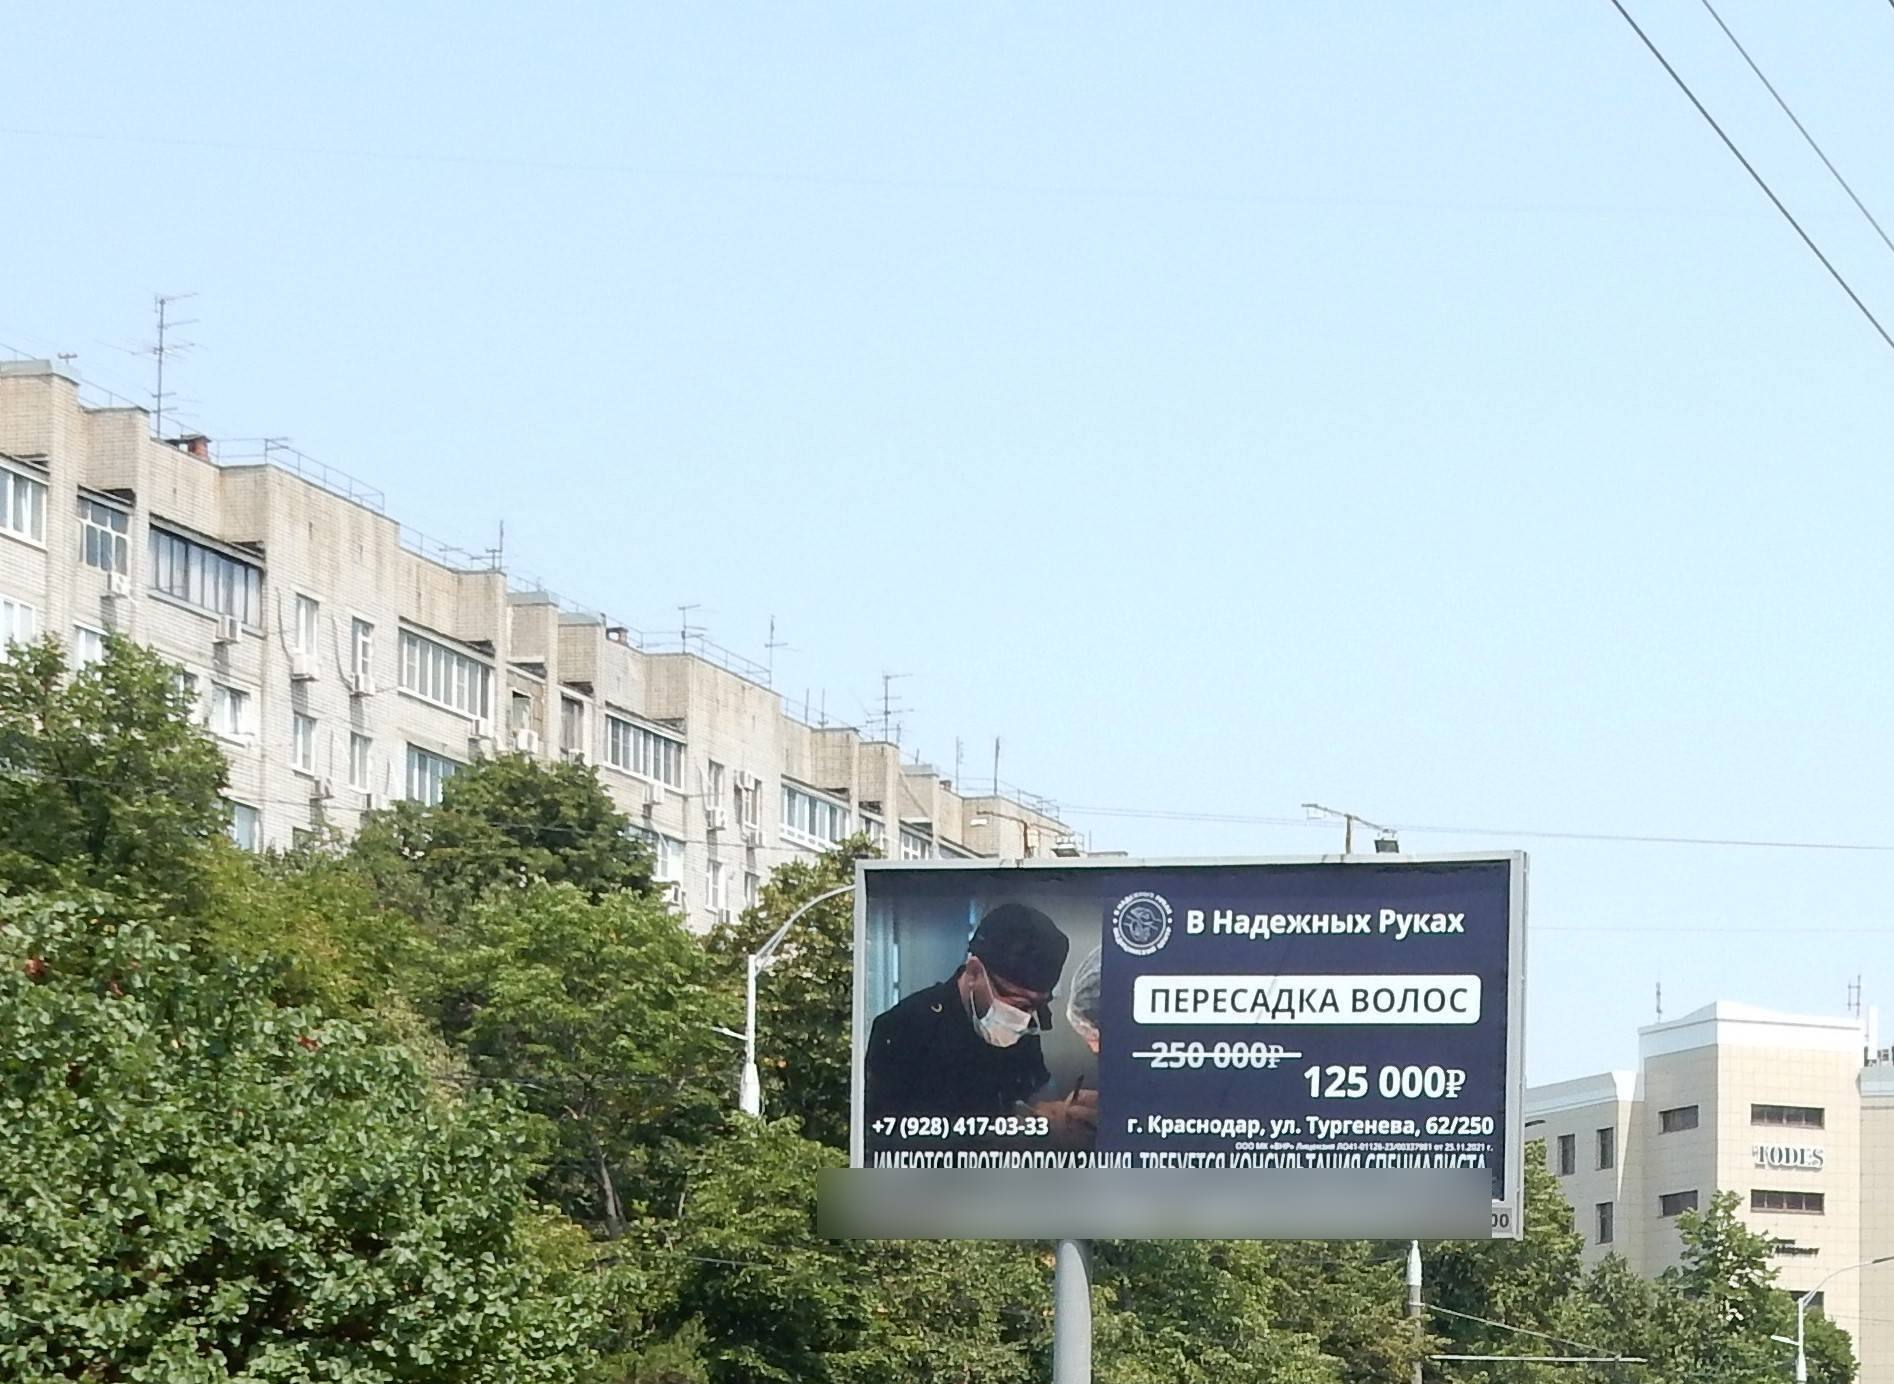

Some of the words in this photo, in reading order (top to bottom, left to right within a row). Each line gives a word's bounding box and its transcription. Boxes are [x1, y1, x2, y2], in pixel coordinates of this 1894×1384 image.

[1187, 911, 1204, 934] В
[1213, 910, 1371, 939] Надежных
[1379, 909, 1465, 940] Руках
[1151, 988, 1340, 1020] ПЕРЕСАДКА
[1352, 988, 1468, 1014] ВОЛОС
[1151, 1041, 1205, 1069] 250
[1304, 1065, 1368, 1098] 125
[1378, 1065, 1466, 1099] 000₽
[872, 1118, 896, 1135] +7
[900, 1117, 950, 1138] (928)
[953, 1117, 1049, 1136] 417-03-33
[1127, 1118, 1143, 1134] г.
[1148, 1115, 1265, 1139] Краснодар,
[1271, 1119, 1302, 1139] ул.
[1306, 1116, 1421, 1138] Тургенева,
[1425, 1116, 1494, 1135] 62/250
